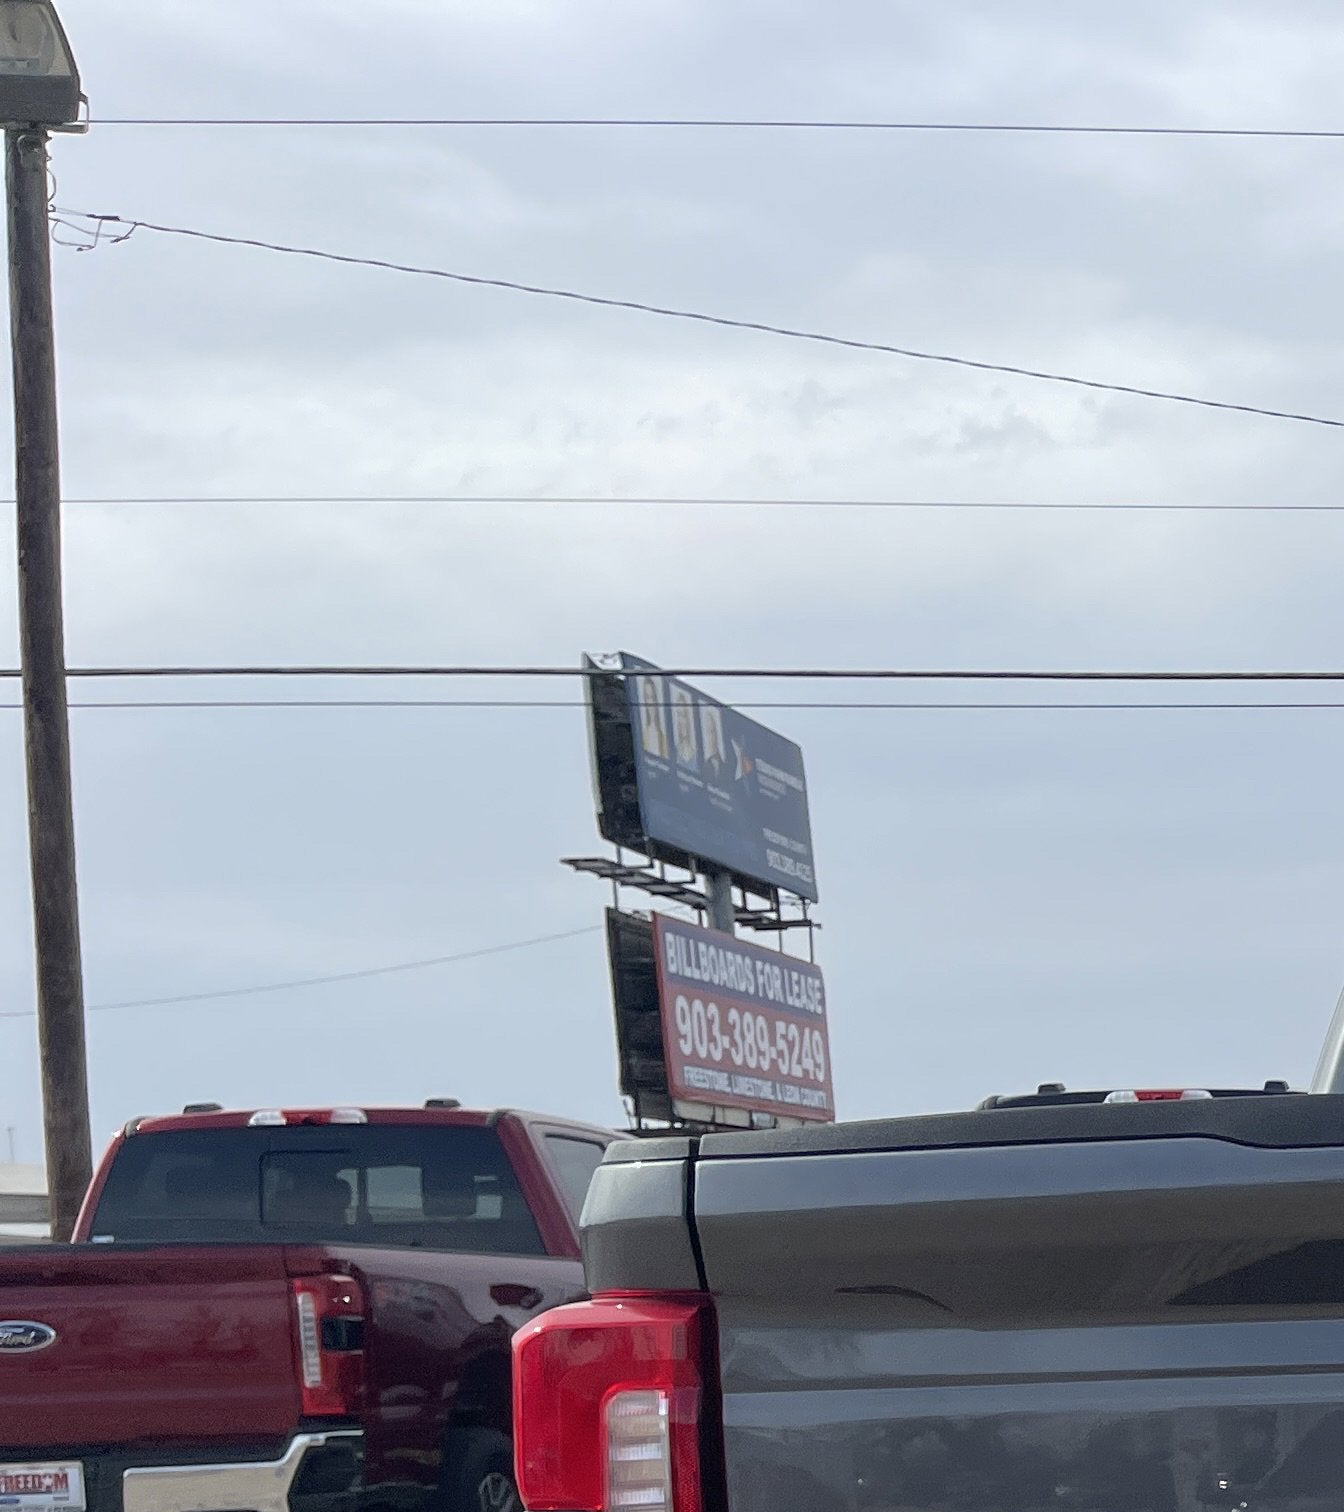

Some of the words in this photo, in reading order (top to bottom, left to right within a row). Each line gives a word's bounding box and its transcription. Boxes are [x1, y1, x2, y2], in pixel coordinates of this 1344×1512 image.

[664, 931, 755, 996] BILLBOARDS
[755, 959, 784, 1003] FOR
[783, 967, 824, 1015] LEASE
[675, 995, 826, 1083] 903-389-5249
